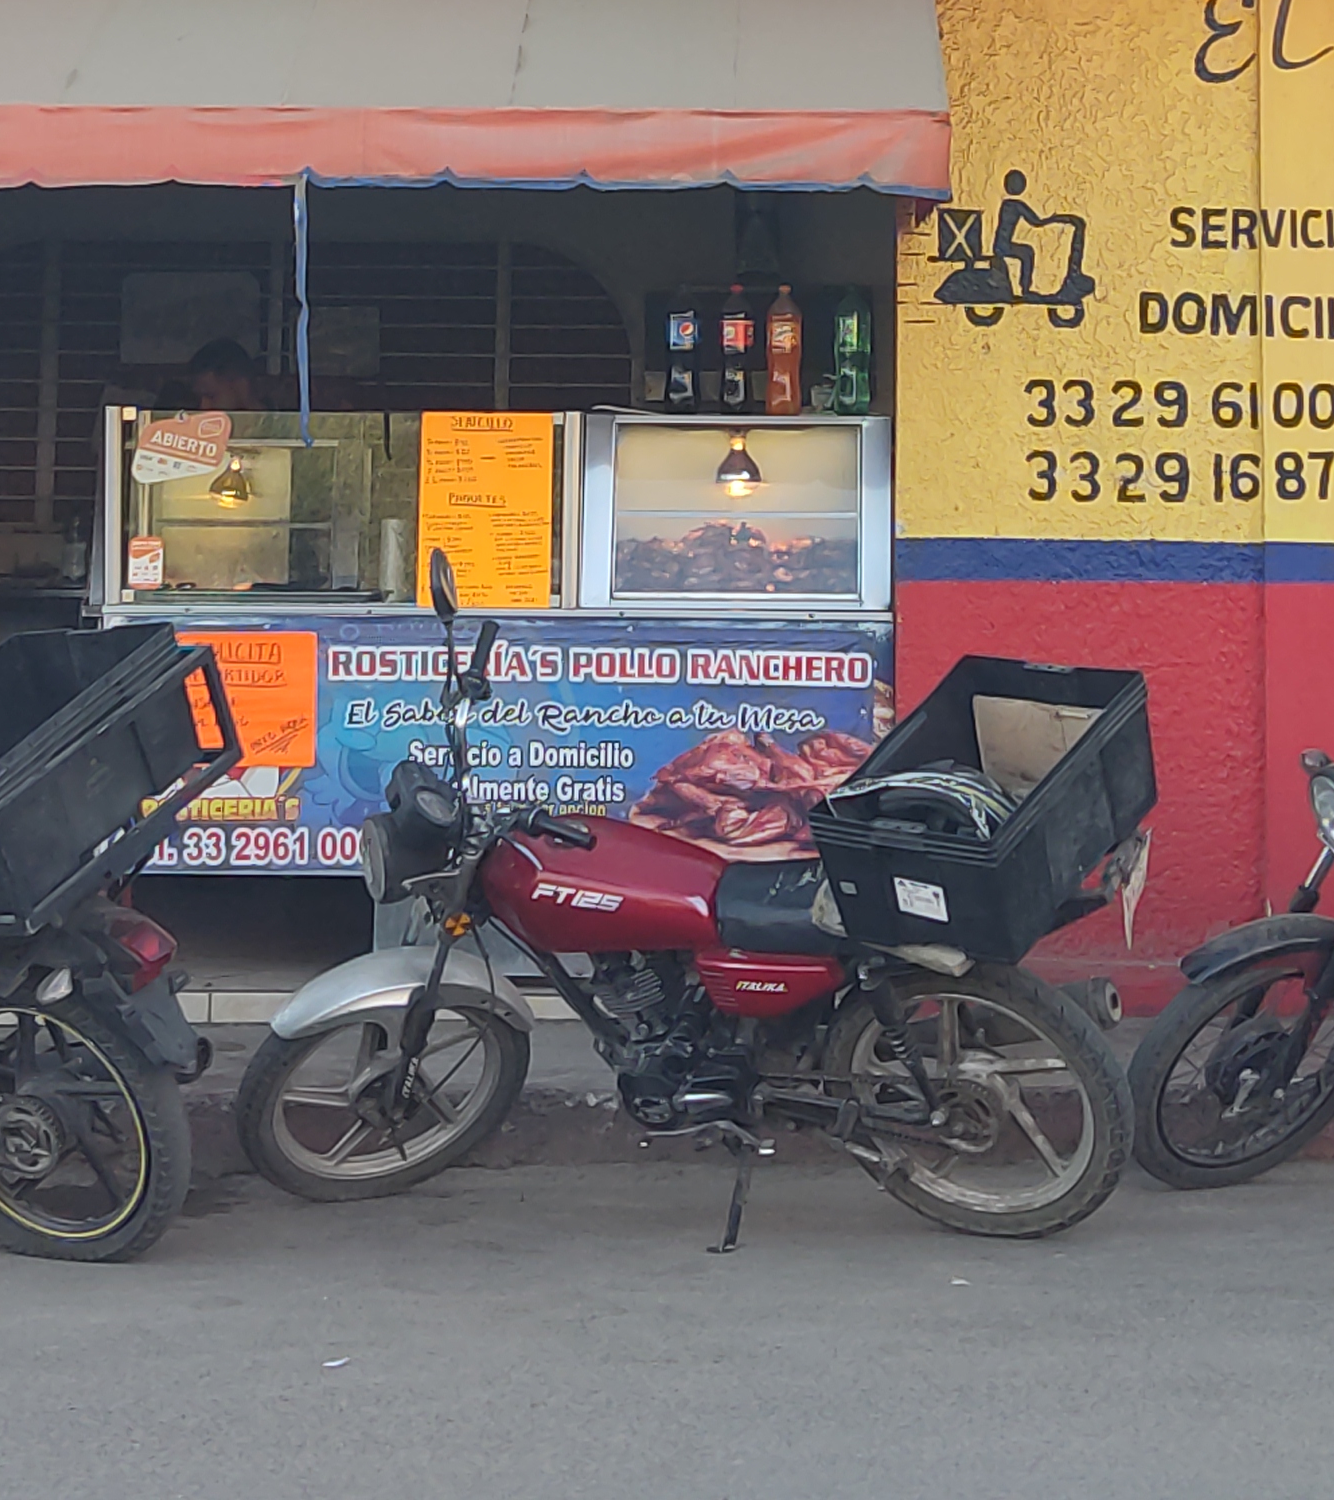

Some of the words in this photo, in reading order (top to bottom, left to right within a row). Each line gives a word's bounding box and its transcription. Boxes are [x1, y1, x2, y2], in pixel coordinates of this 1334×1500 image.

[149, 429, 218, 458] ABIERTO
[571, 649, 678, 680] POLLO
[688, 651, 870, 685] RANCHERO
[348, 700, 375, 726] El
[383, 700, 474, 728] Sab
[482, 700, 532, 725] del
[537, 701, 661, 735] Rancho
[669, 709, 693, 728] a
[696, 702, 736, 730] tu
[737, 703, 826, 732] Mesa
[508, 746, 523, 767] a
[529, 741, 634, 768] Domicilio
[556, 776, 625, 803] Gratis
[184, 829, 225, 864] 33
[233, 829, 308, 864] 2961
[319, 830, 365, 864] 00
[530, 882, 624, 912] FT125
